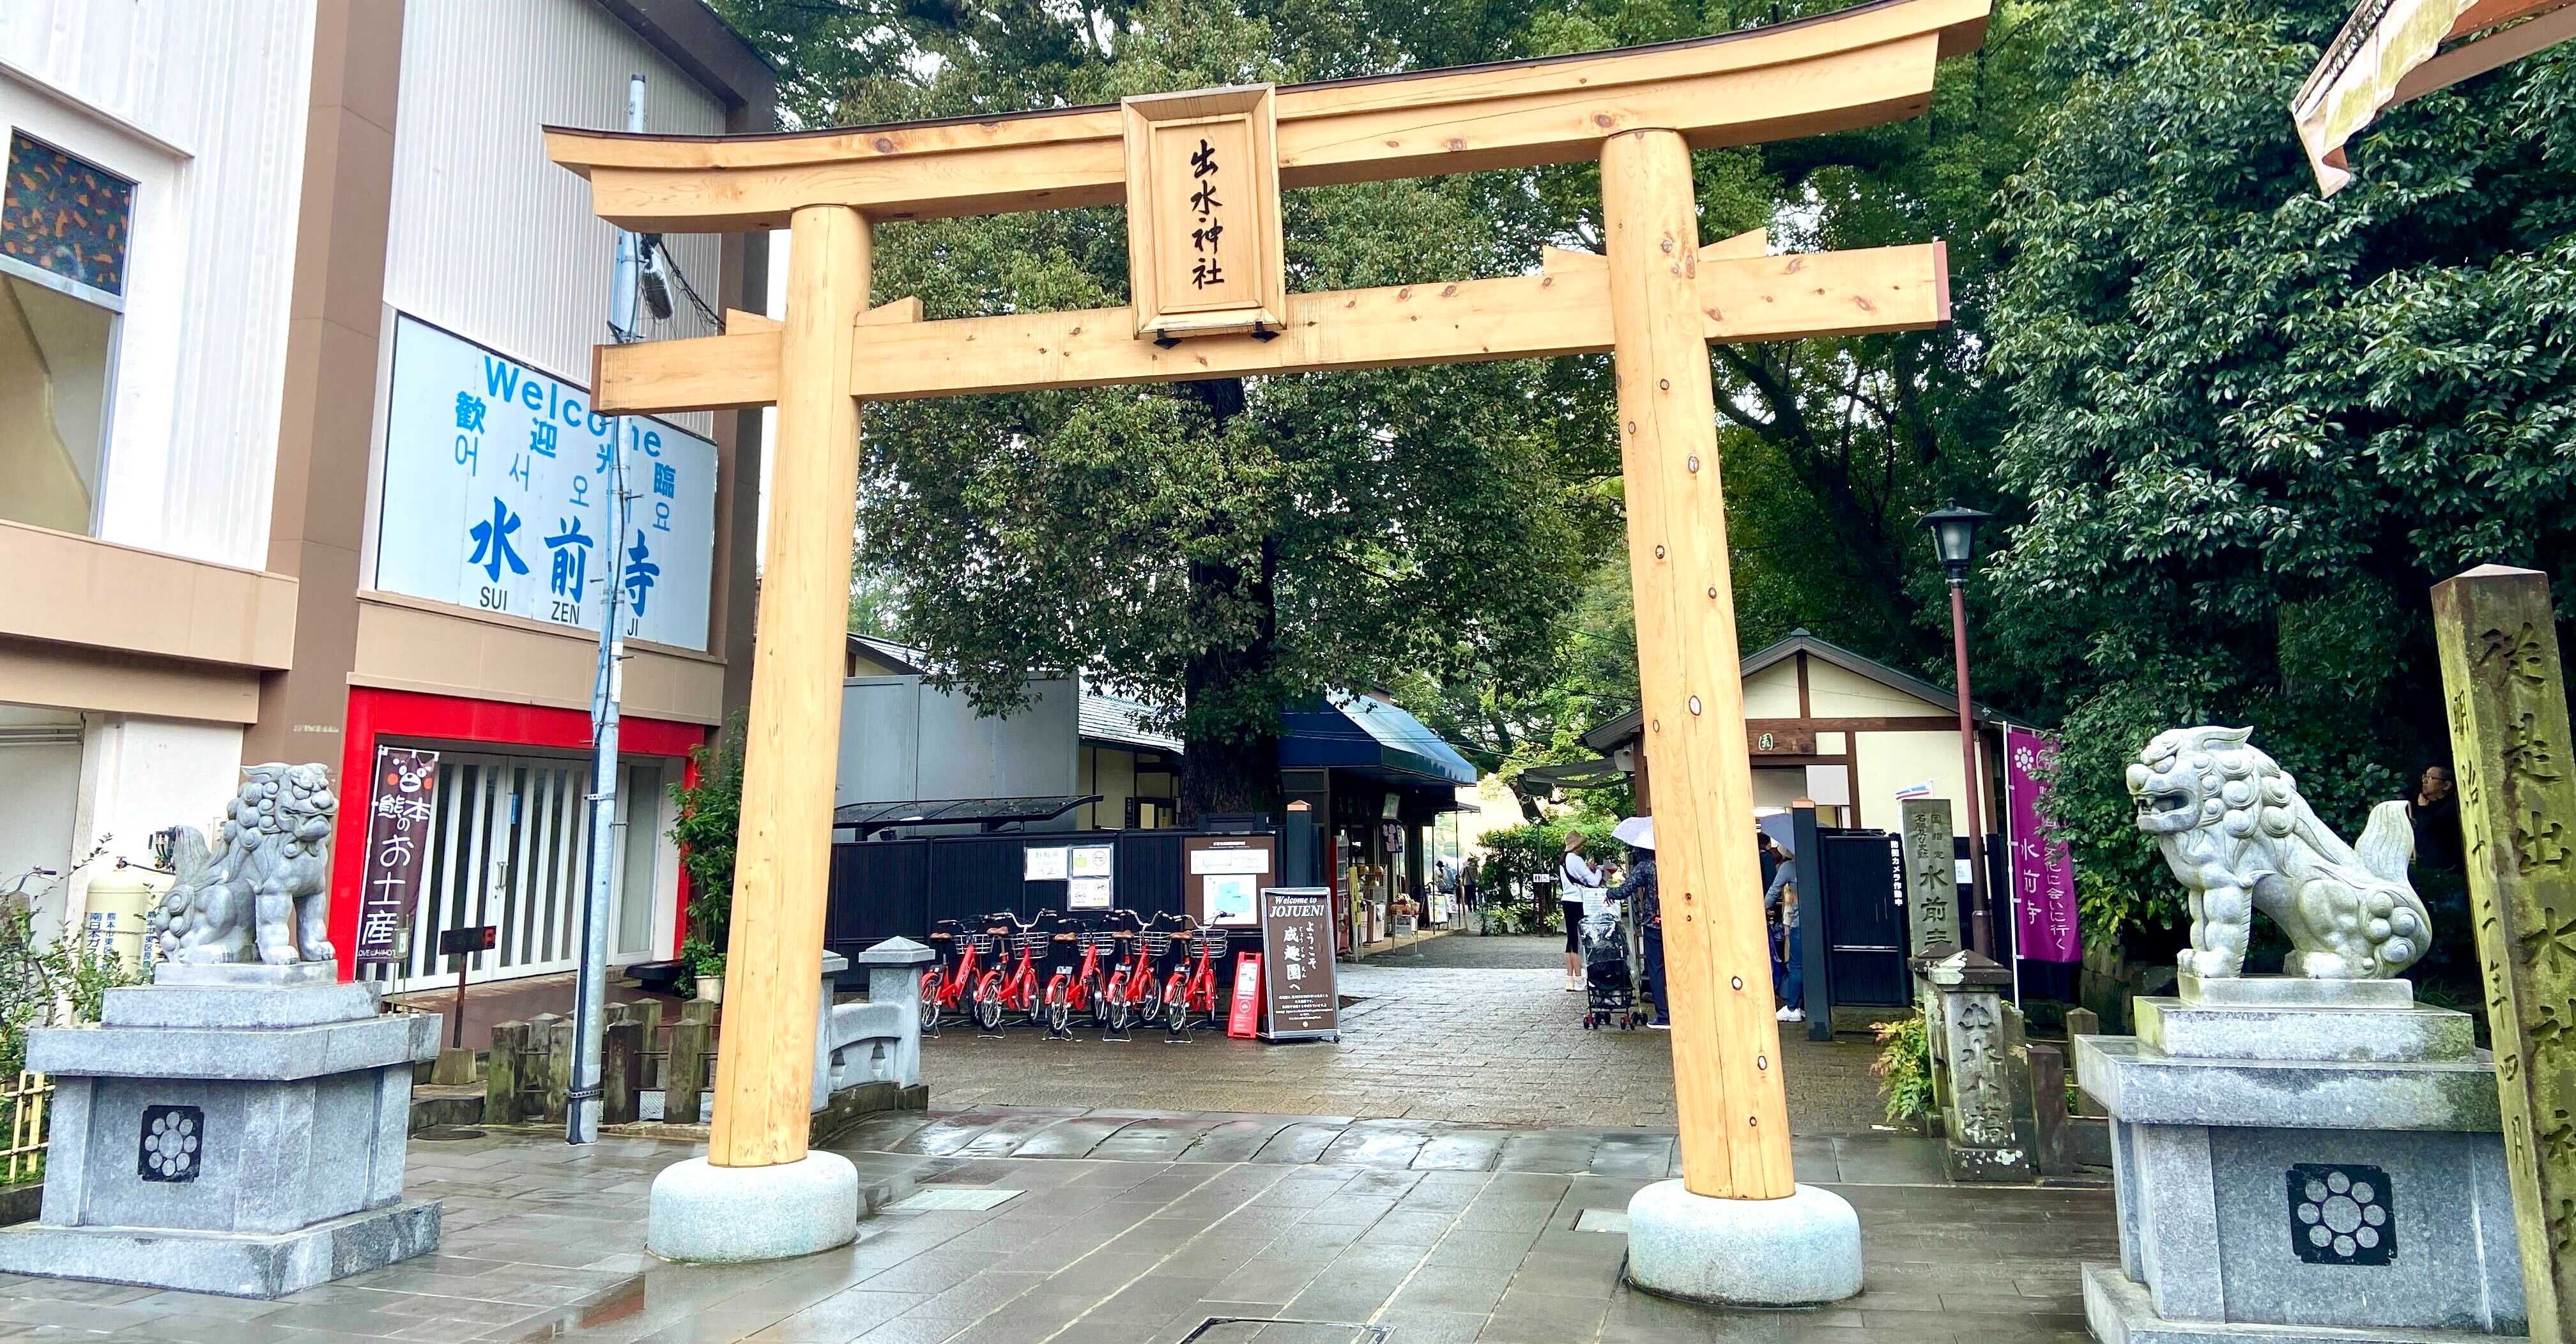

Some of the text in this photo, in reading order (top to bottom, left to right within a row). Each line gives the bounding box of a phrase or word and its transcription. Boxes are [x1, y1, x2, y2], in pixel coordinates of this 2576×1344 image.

[1190, 139, 1225, 290] 出水神社
[455, 434, 670, 532] 어서오요
[468, 496, 660, 617] 水前寺
[479, 586, 638, 636] SUI ZEN JI
[362, 793, 431, 945] 熊本のお土産
[1269, 905, 1324, 918] JOJUEN!
[1275, 896, 1308, 905] Welcome
[2020, 837, 2042, 925] 水前寺
[1306, 921, 1317, 970] ようこそ
